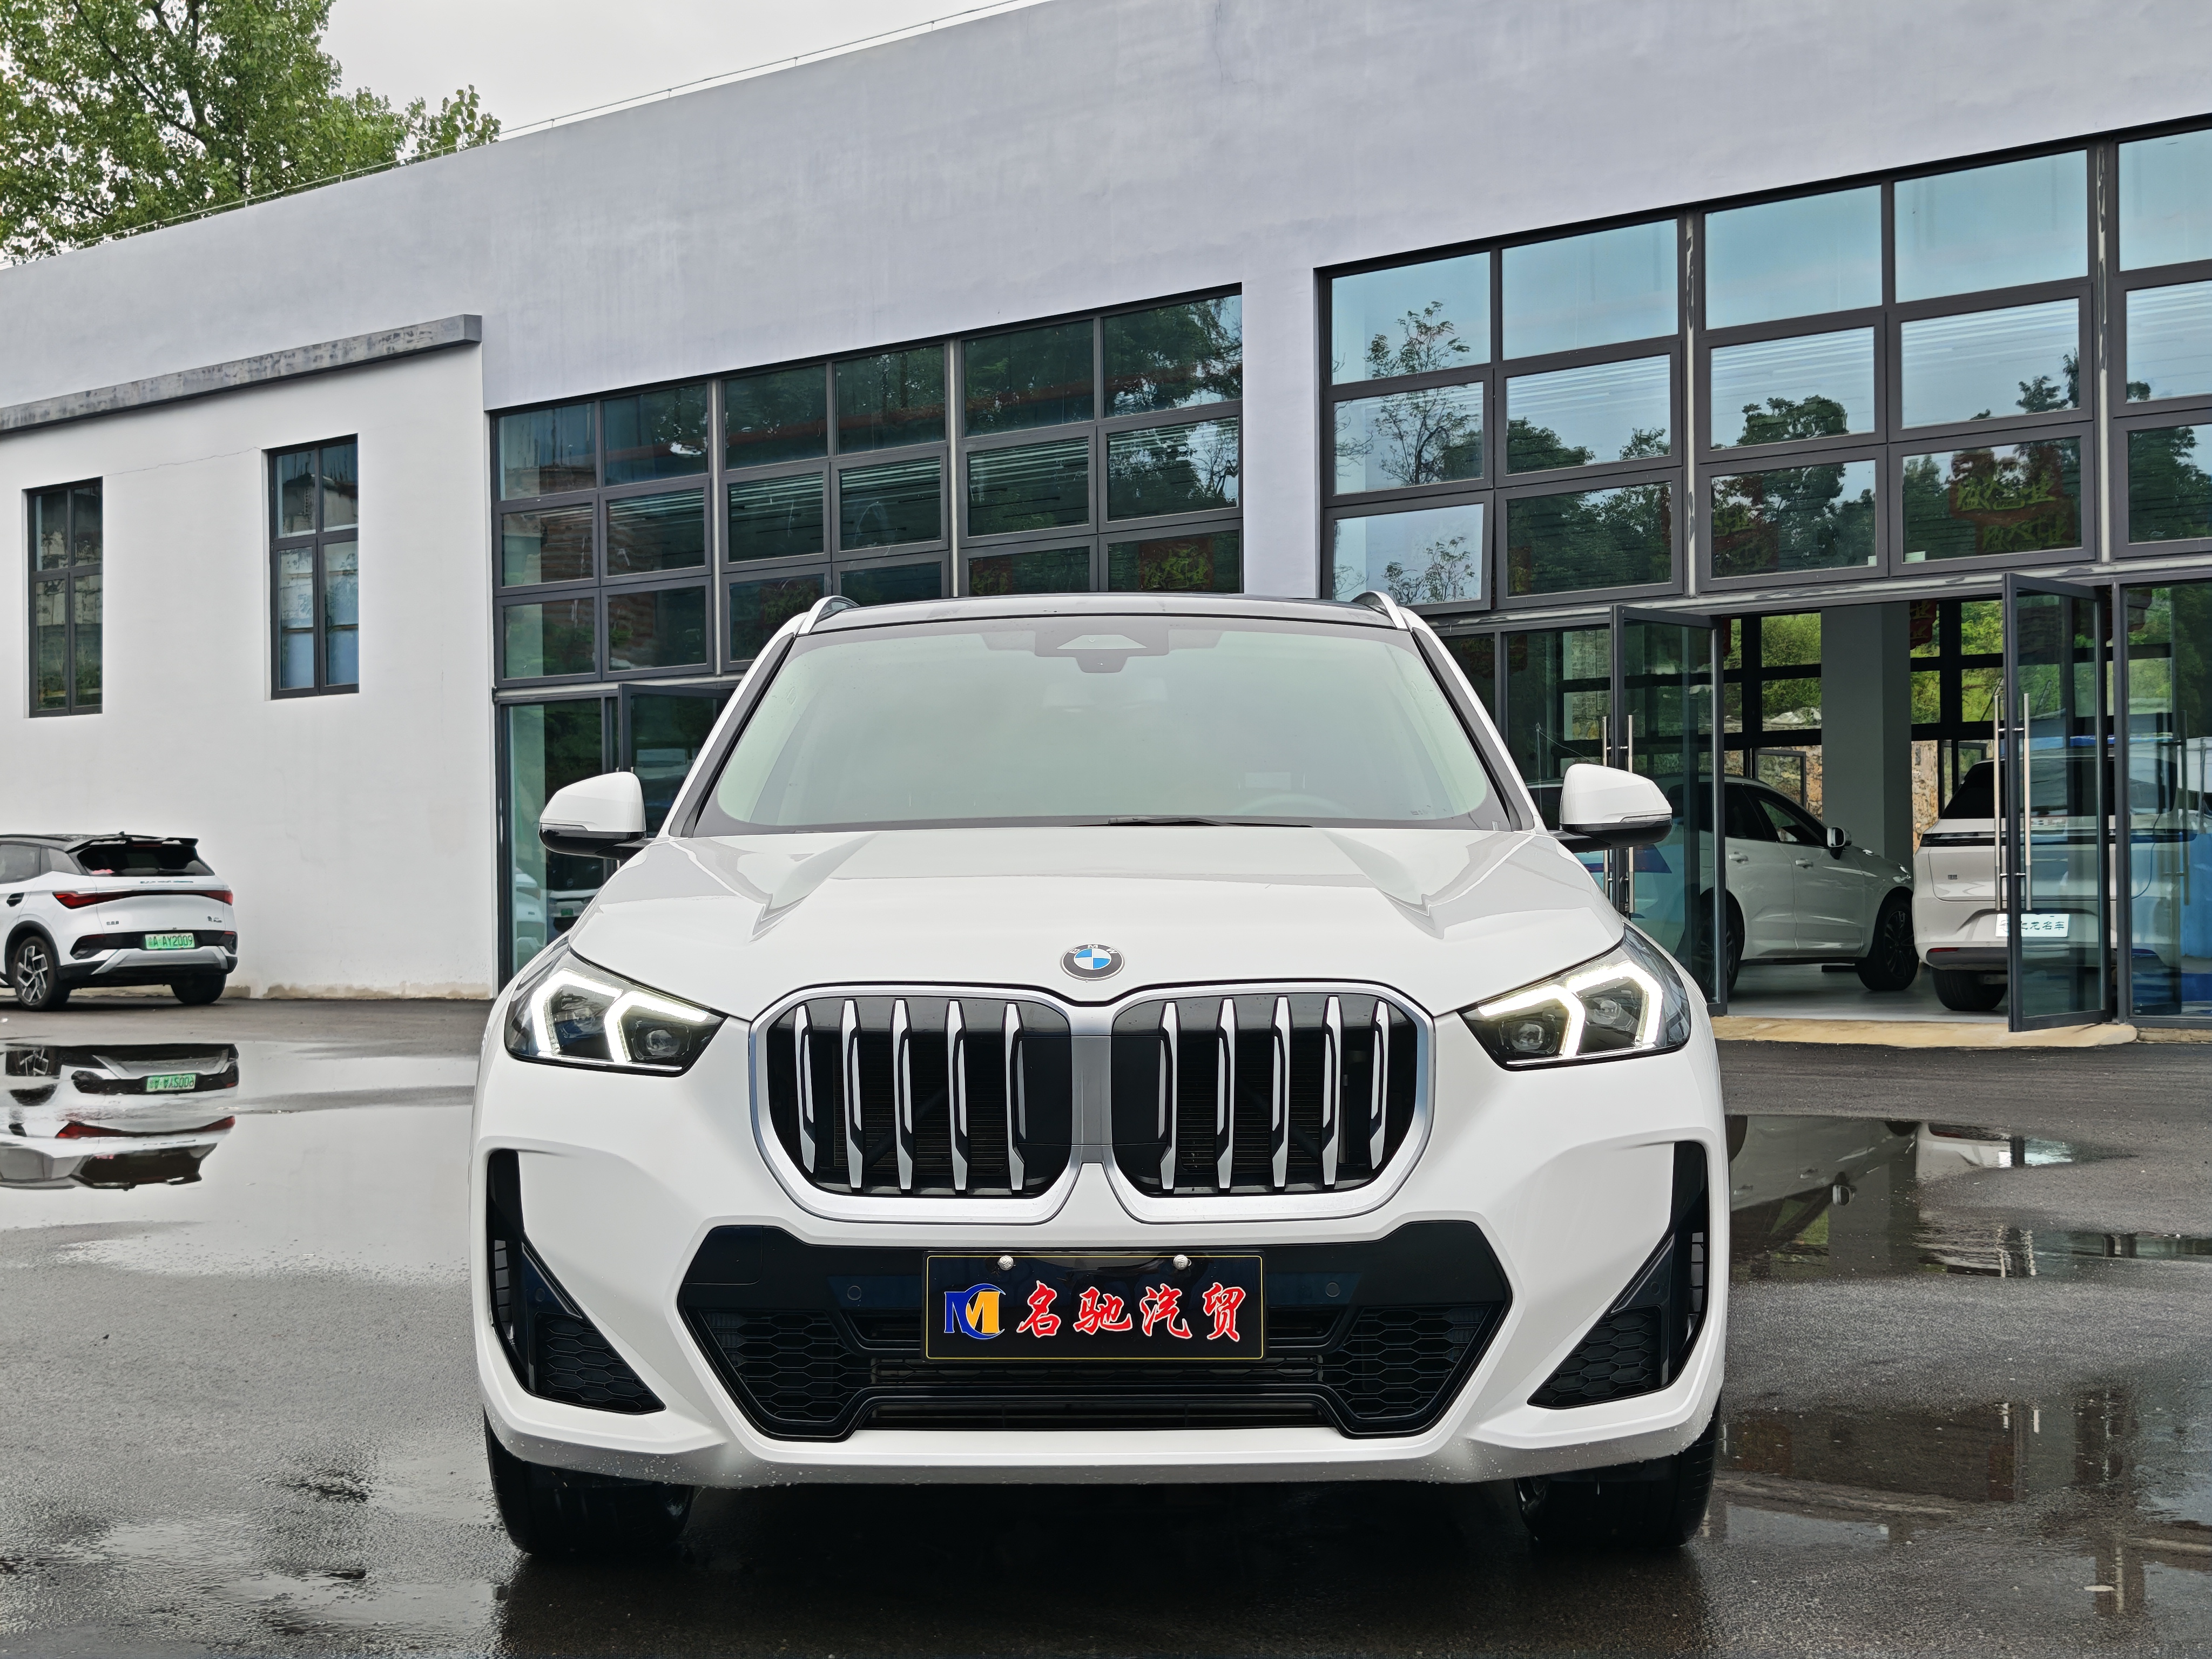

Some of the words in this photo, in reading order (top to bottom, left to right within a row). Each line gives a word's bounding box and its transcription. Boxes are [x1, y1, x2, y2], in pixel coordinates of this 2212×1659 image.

[1069, 944, 1118, 954] BMW
[1016, 1280, 1246, 1342] 名驰汽贸
